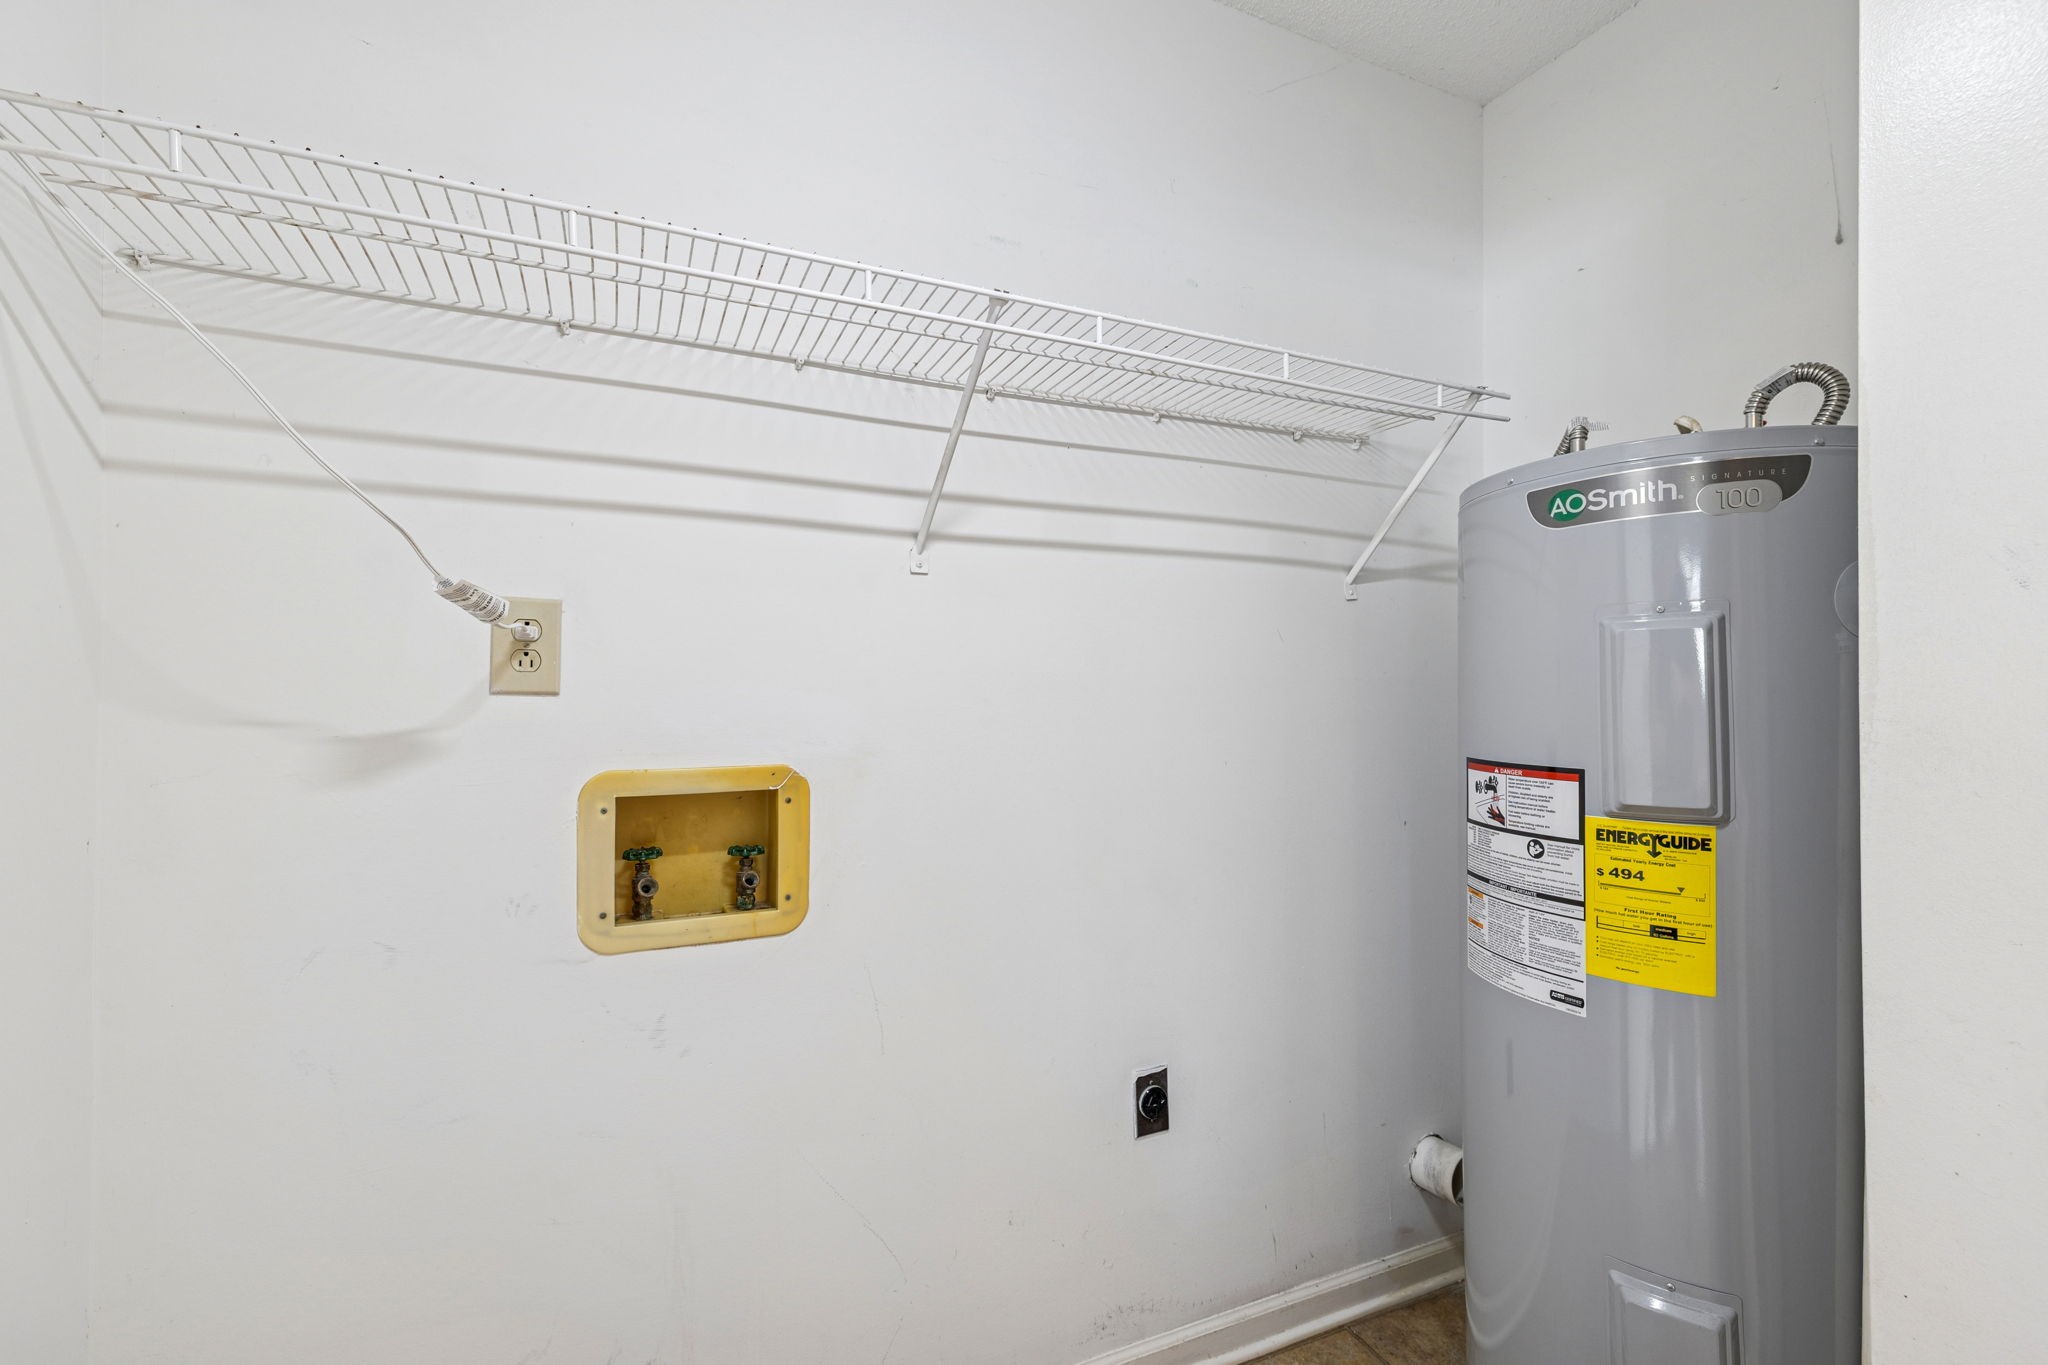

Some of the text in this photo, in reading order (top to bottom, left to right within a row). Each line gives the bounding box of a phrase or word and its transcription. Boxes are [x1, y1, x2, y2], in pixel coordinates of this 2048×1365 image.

[1690, 467, 1787, 482] SIGNATURE
[1715, 486, 1763, 510] 100
[1500, 768, 1522, 776] DANGER
[1595, 828, 1712, 853] ENERGYGUIDE
[1596, 867, 1645, 881] $ 494
[1656, 911, 1677, 920] Rating
